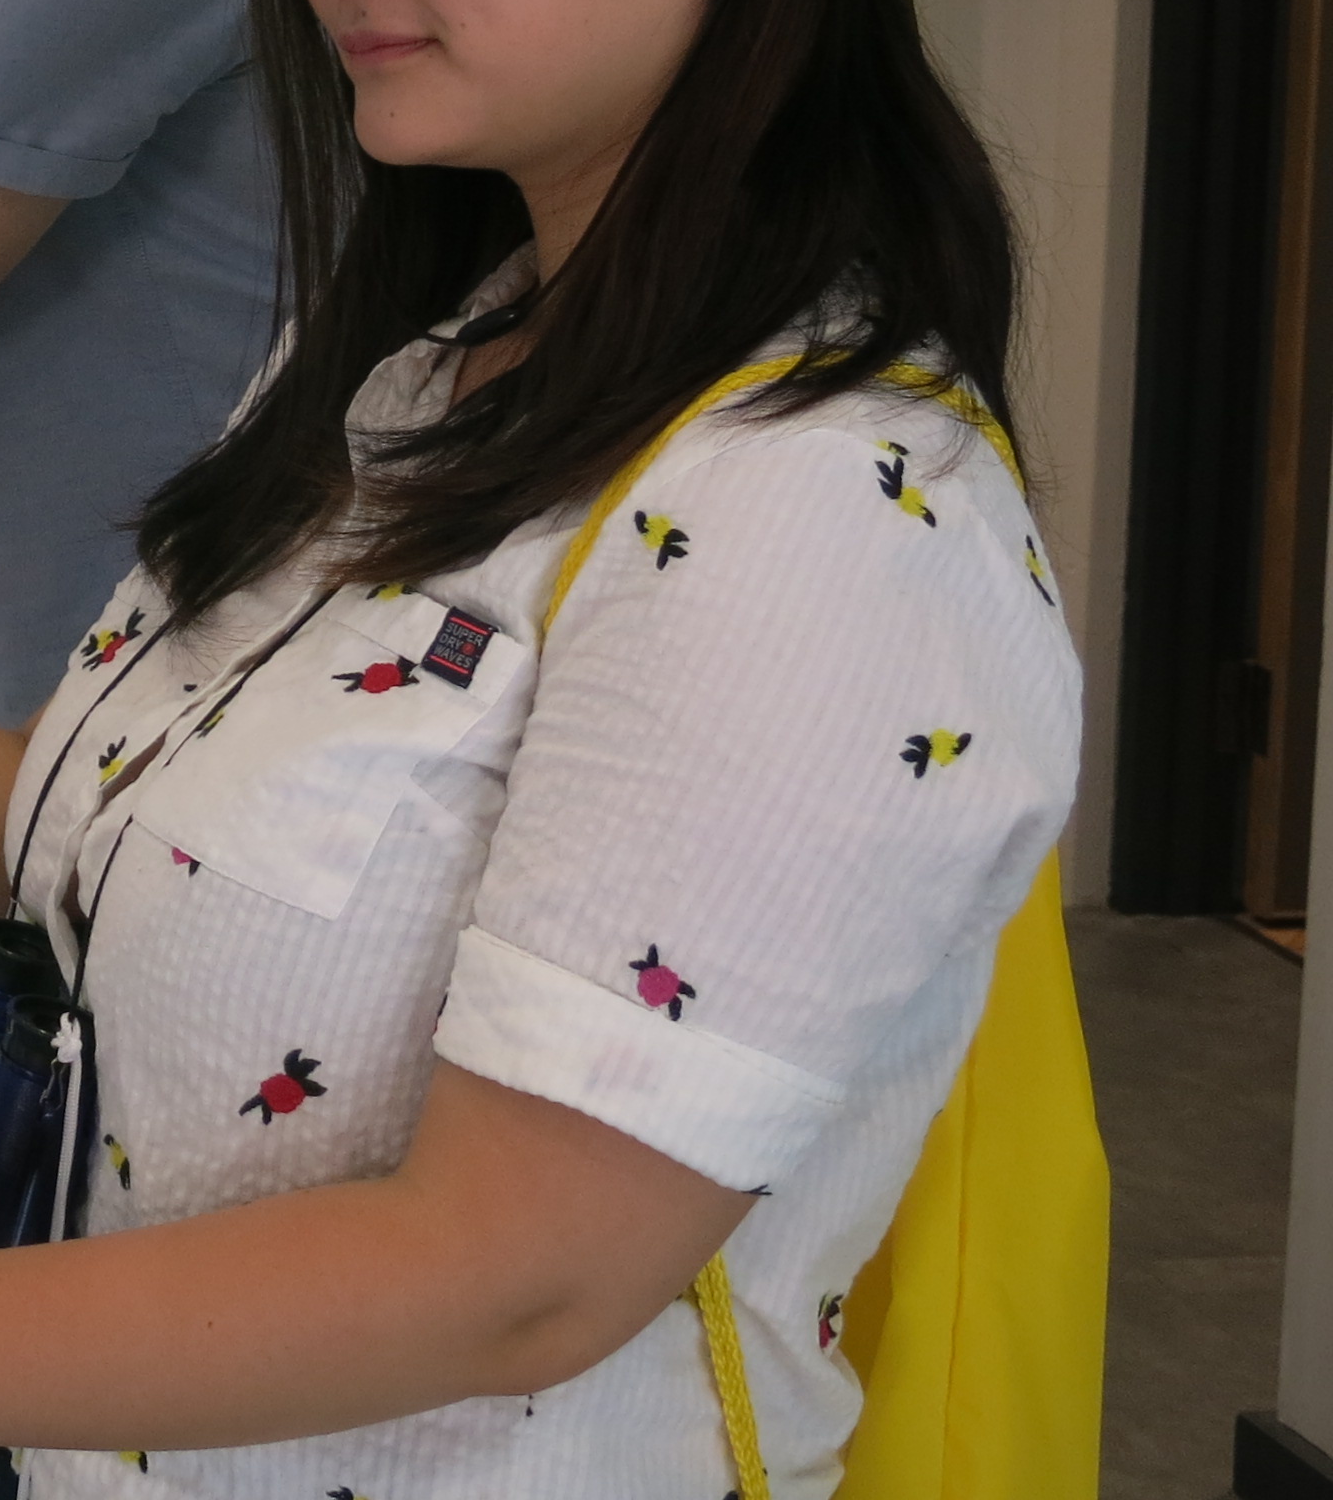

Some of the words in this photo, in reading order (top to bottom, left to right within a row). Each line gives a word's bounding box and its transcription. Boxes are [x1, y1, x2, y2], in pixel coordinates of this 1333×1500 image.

[438, 633, 464, 650] DRY
[445, 622, 484, 648] SUPER
[433, 644, 474, 668] WAVES
